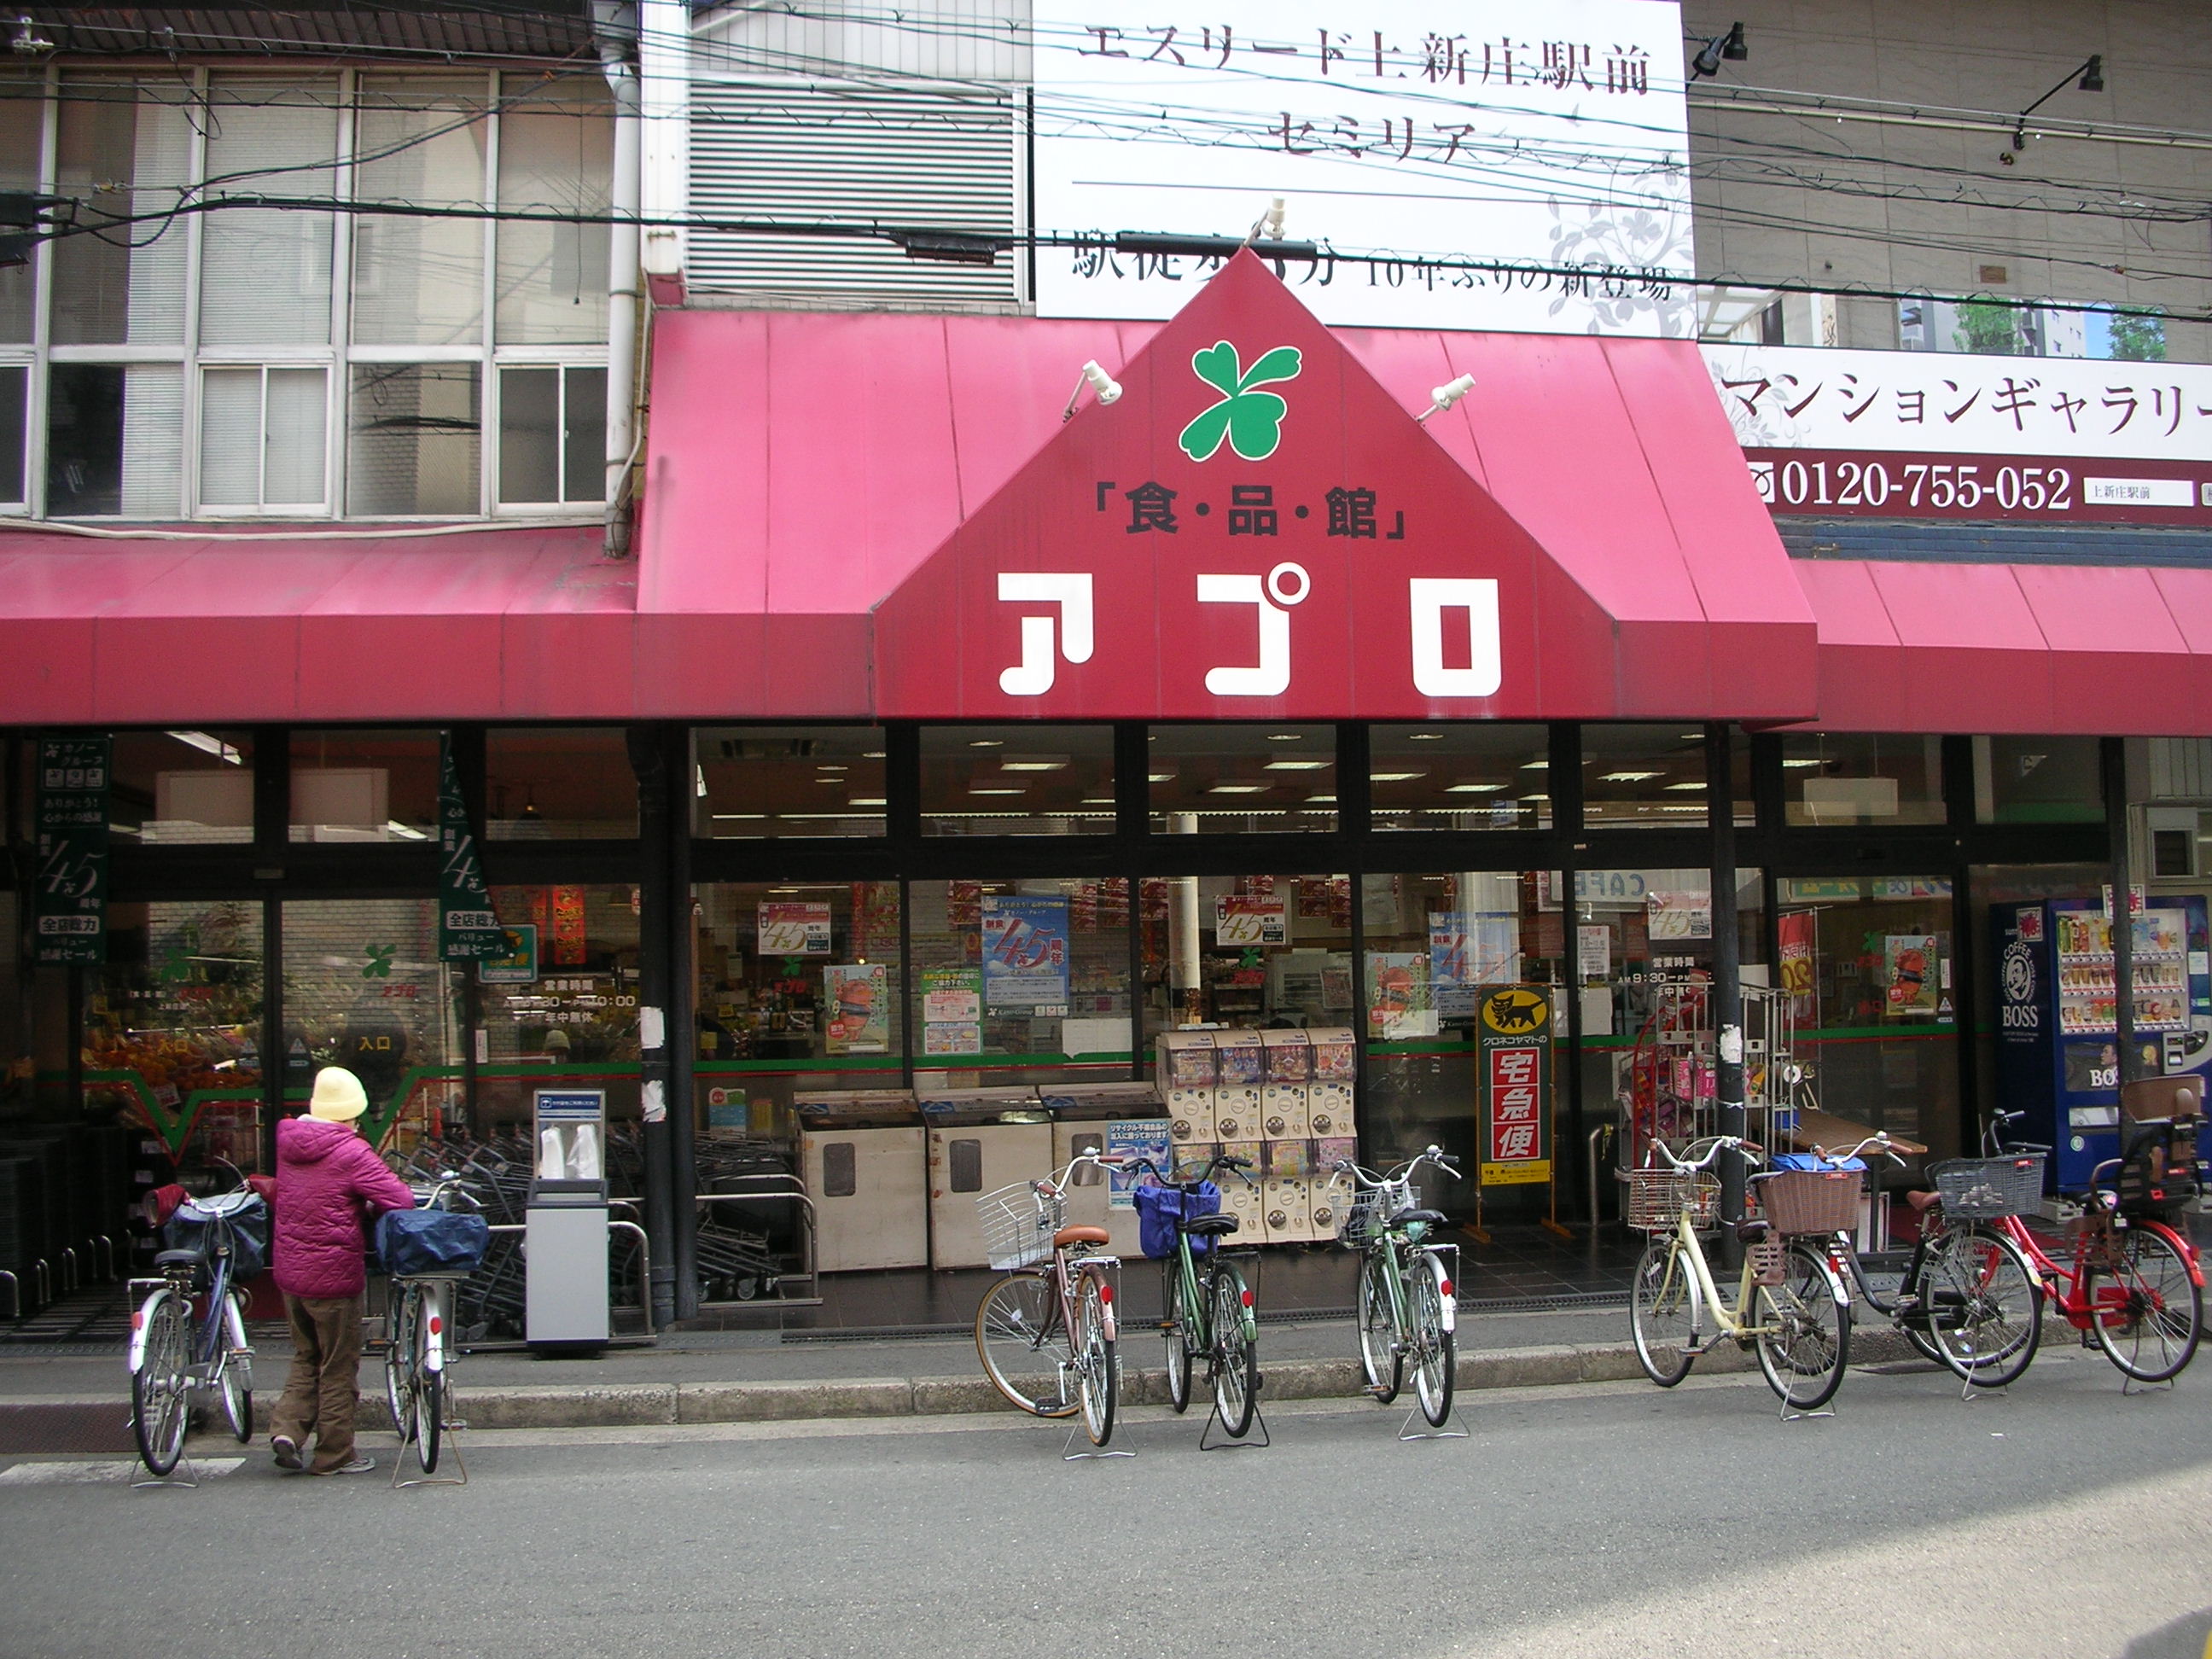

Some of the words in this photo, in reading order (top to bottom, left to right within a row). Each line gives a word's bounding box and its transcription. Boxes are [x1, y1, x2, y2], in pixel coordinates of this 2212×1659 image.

[1078, 25, 1650, 96] エスリード上新庄駅前
[1268, 112, 1475, 164] セミリア
[1781, 459, 2071, 510] 0120-755-052
[2093, 485, 2151, 499] 上新庄駅前
[1097, 481, 1406, 539] 「食・品・館」
[998, 562, 1502, 696] アプロ
[763, 911, 811, 952] 45
[993, 917, 1057, 969] 45
[1220, 903, 1266, 943] 45
[1652, 956, 1695, 969] 営業時間
[2003, 941, 2032, 961] COFFEE
[2002, 1004, 2040, 1028] BOSS
[358, 1035, 391, 1051] 入口
[1482, 1035, 1548, 1046] クロネコヤマトの
[1498, 1051, 1535, 1158] 宅急便
